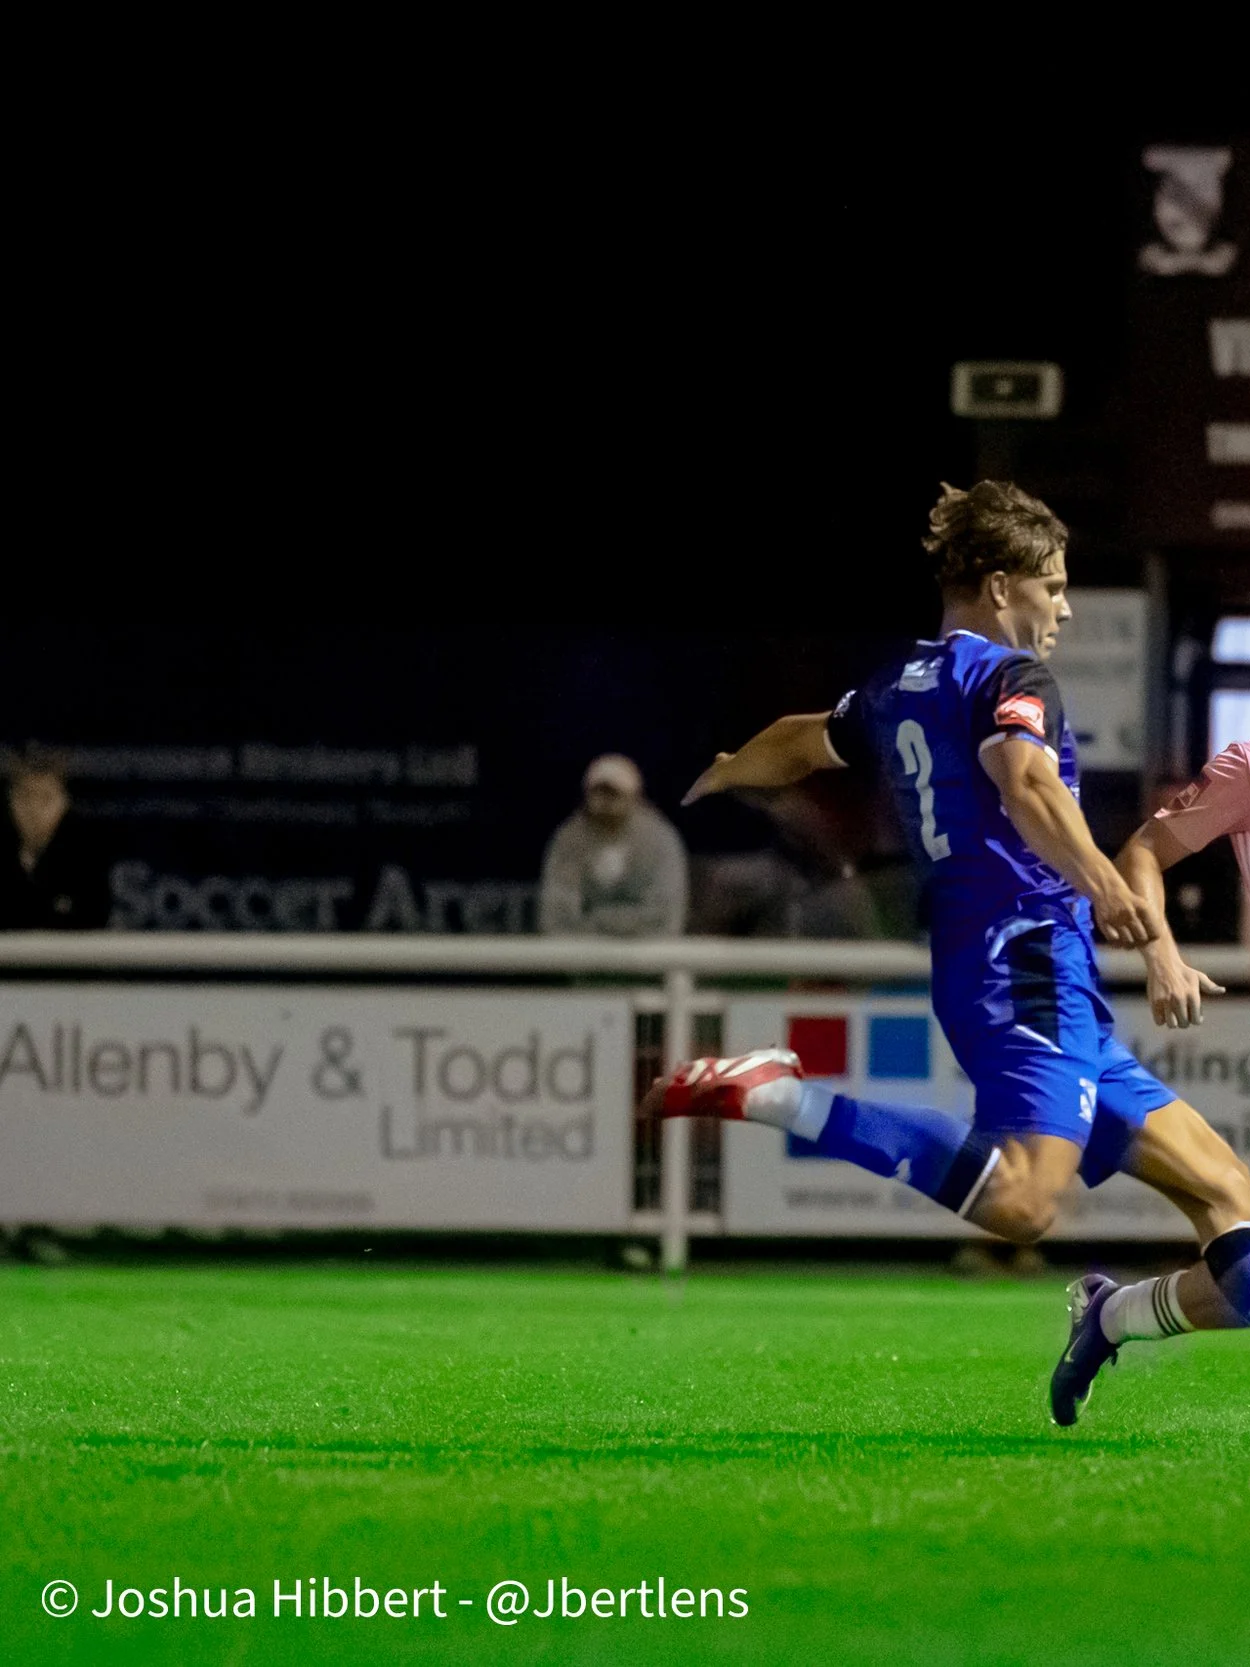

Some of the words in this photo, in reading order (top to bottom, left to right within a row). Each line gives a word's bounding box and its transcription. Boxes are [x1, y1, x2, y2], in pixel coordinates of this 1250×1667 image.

[896, 719, 951, 861] 2
[0, 1021, 284, 1116] Allenby
[309, 1025, 363, 1100] &
[393, 1028, 596, 1102] Todd
[380, 1105, 595, 1161] Limited
